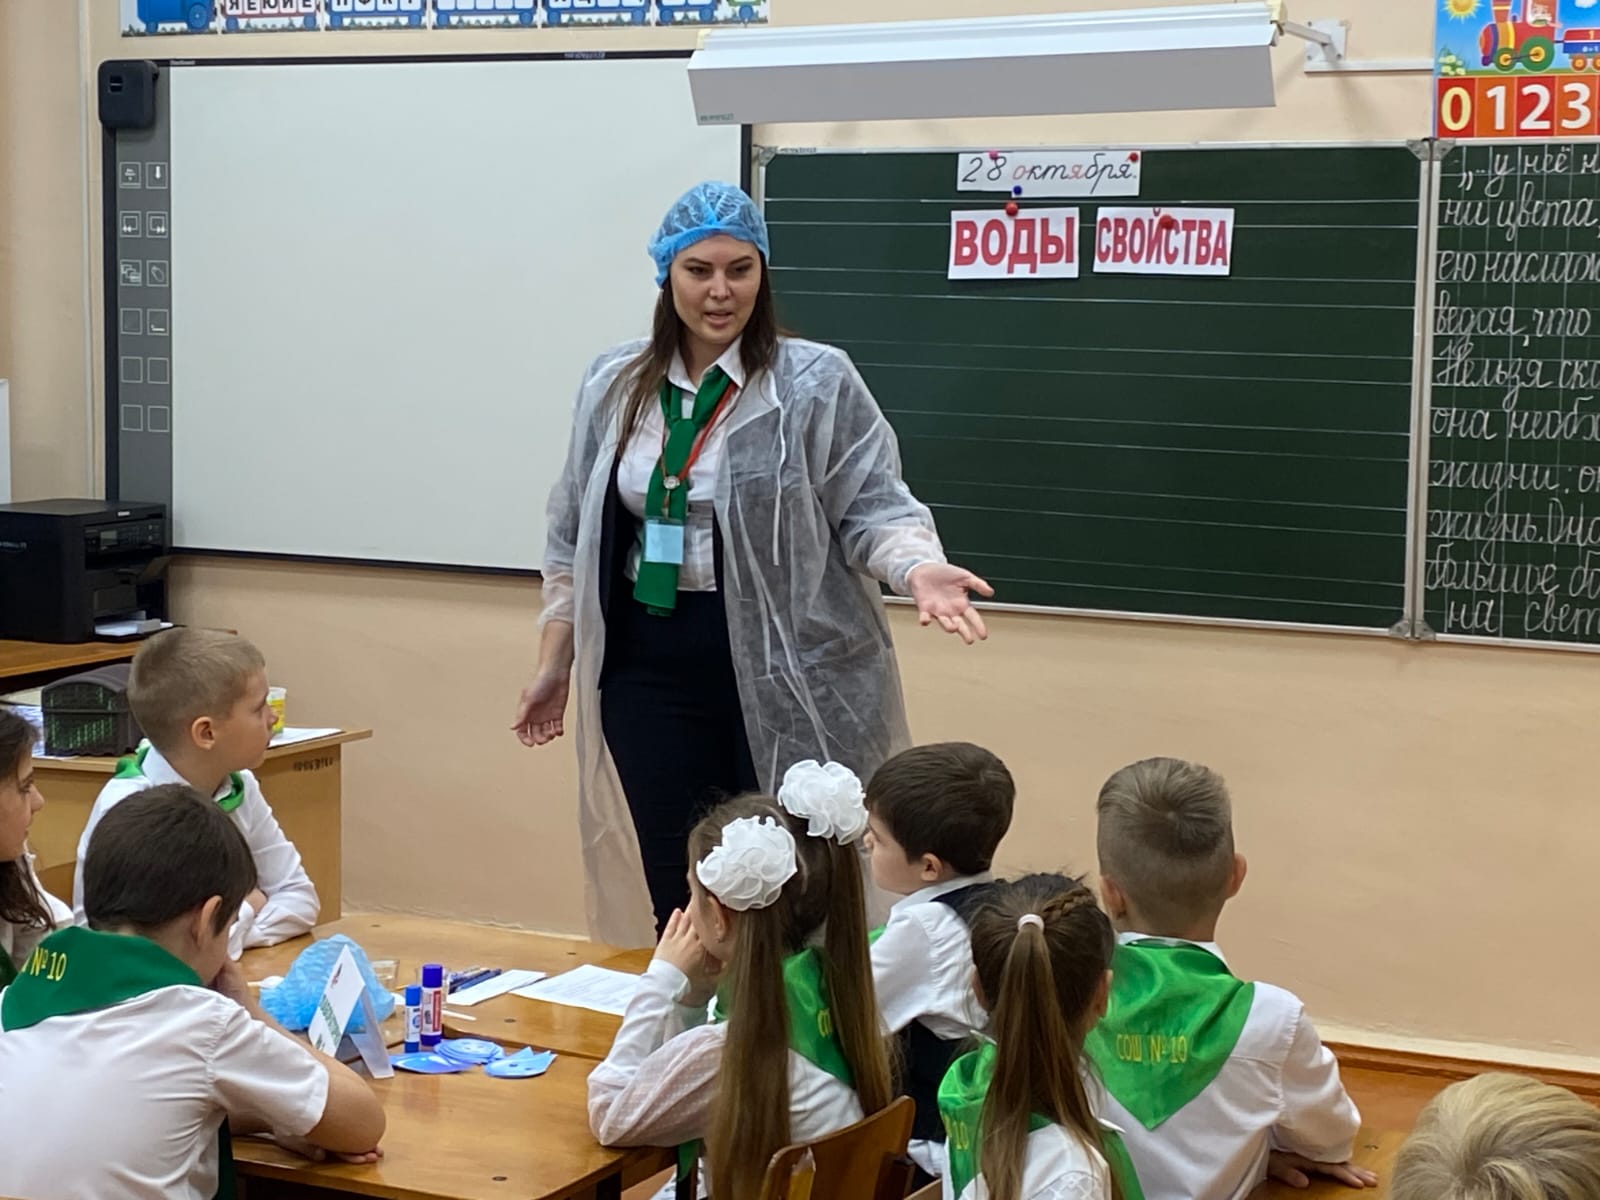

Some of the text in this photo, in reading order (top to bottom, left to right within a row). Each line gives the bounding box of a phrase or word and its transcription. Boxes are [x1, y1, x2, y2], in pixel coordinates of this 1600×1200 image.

[1441, 82, 1592, 131] 0 1 2 3
[1443, 198, 1490, 226] ни
[954, 217, 1076, 275] ВОДЫ
[1096, 207, 1228, 267] СВОЙСТВА
[1432, 408, 1498, 440] она
[1448, 599, 1499, 633] на
